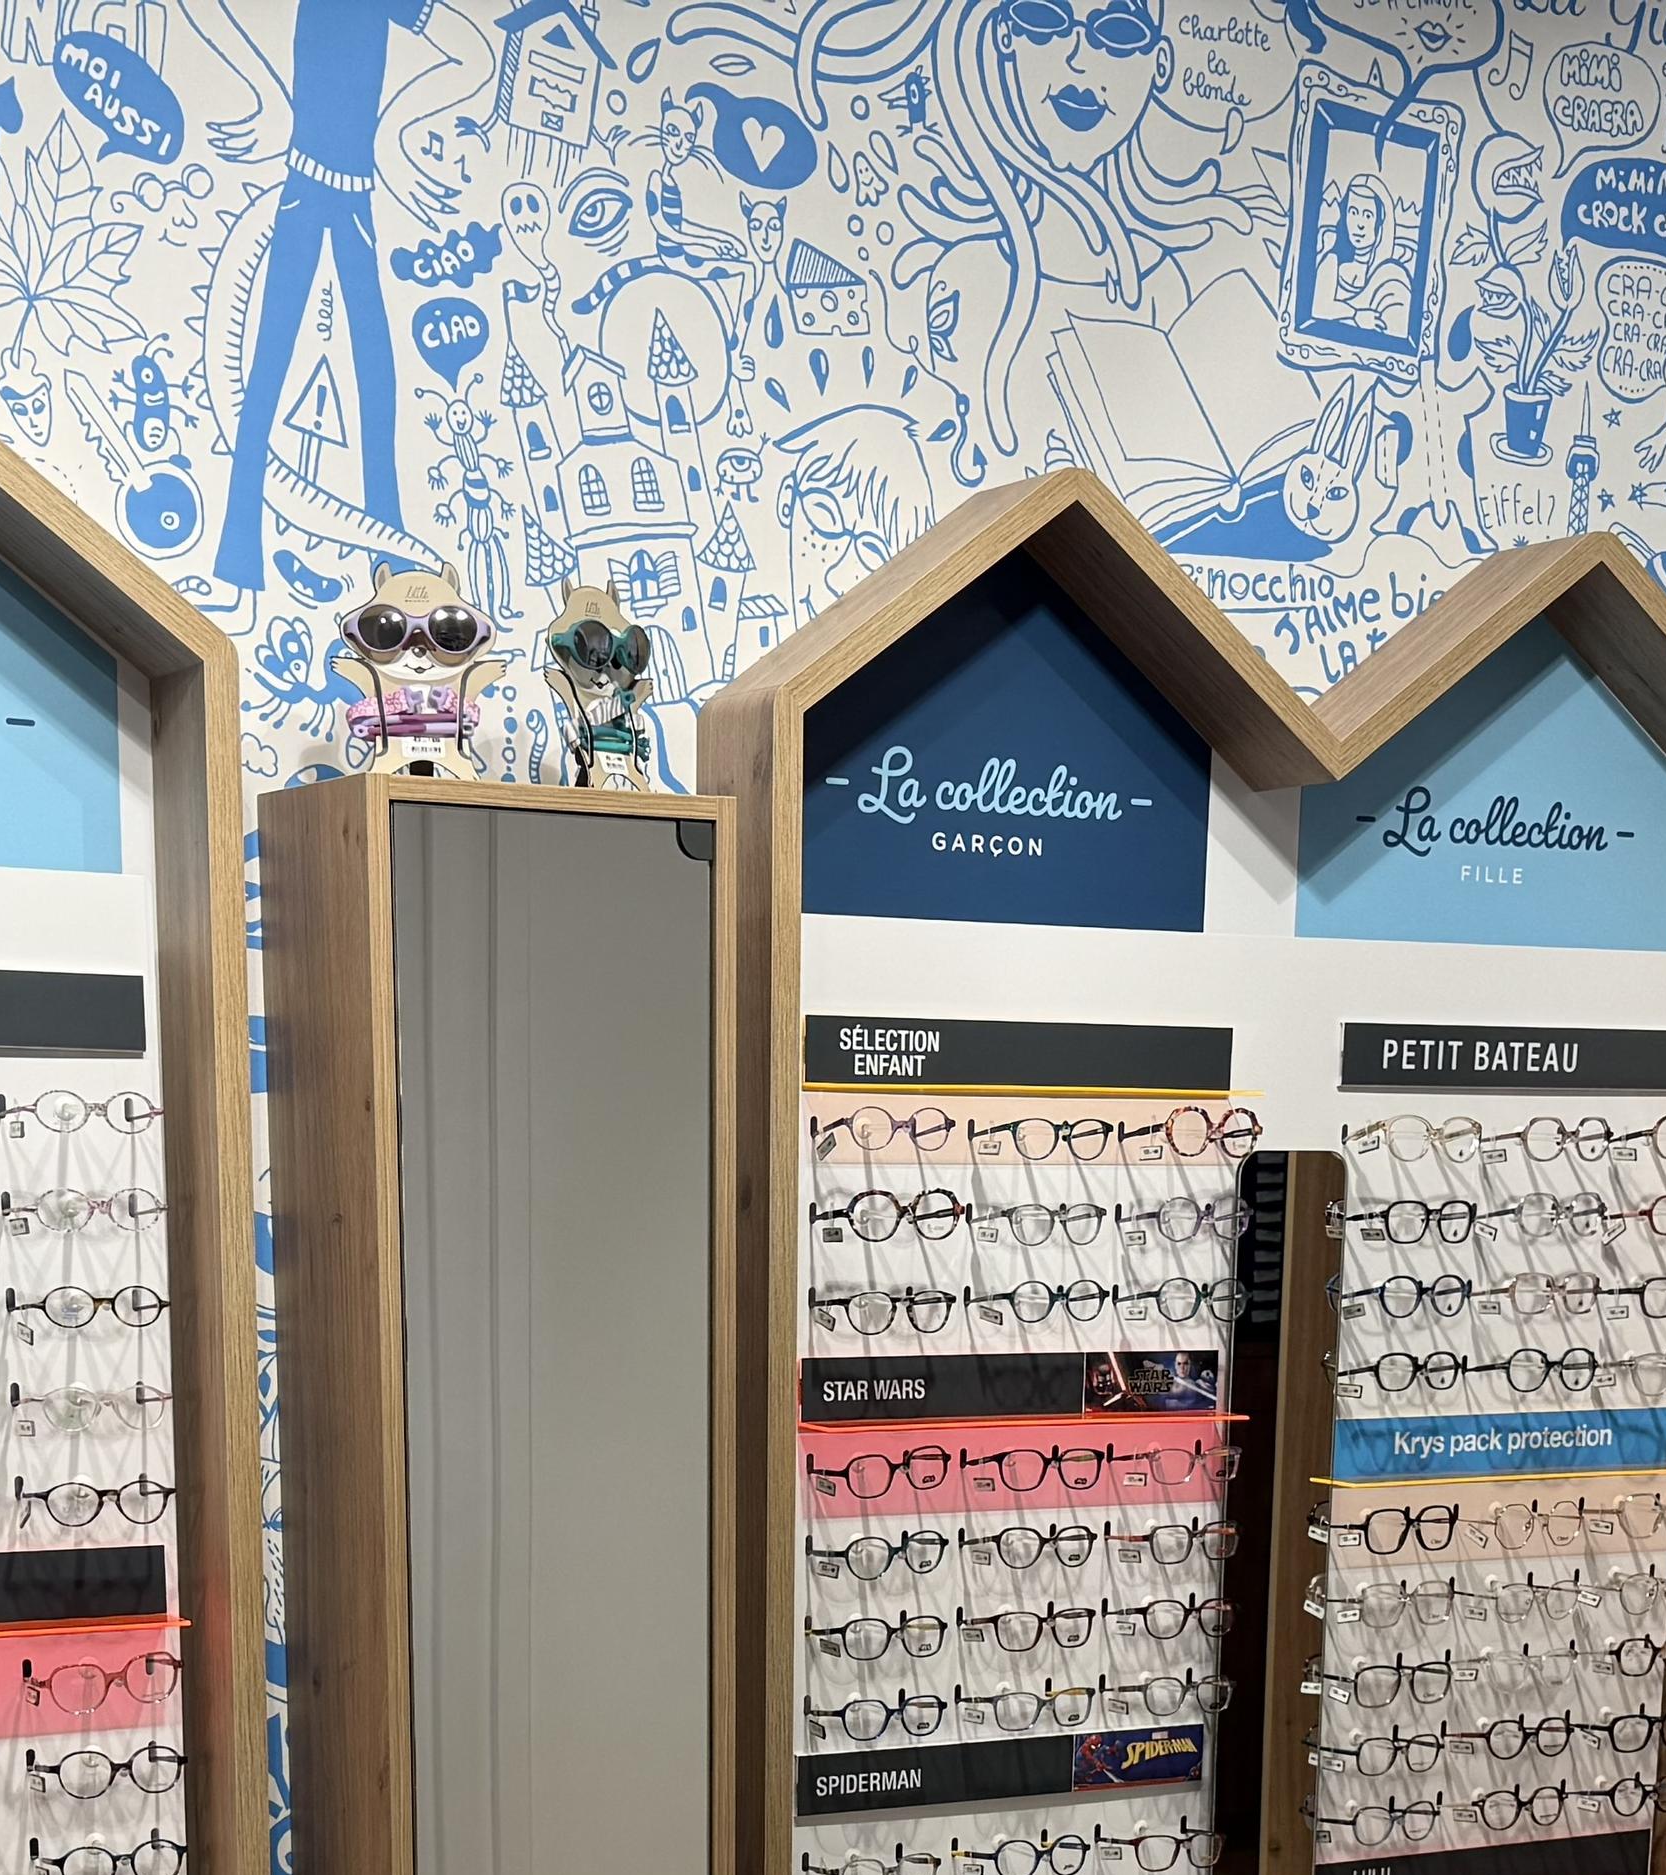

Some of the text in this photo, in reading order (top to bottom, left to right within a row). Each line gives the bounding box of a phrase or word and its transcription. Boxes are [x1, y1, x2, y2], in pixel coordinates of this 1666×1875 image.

[1182, 67, 1252, 106] blonde
[83, 86, 173, 155] AUSSI
[1577, 200, 1648, 235] CROCK
[857, 745, 1123, 824] La collection
[1383, 786, 1608, 857] La collection
[932, 832, 1044, 857] GARÇON
[1460, 865, 1524, 884] FILLE
[839, 1025, 940, 1053] SÉLECTION
[1382, 1039, 1579, 1073] PETIT BATEAU
[854, 1055, 926, 1077] ENFANT
[822, 1378, 926, 1402] STAR WARS
[1393, 1424, 1612, 1458] Krys pack protection
[816, 1769, 922, 1796] SPIDERMAN
